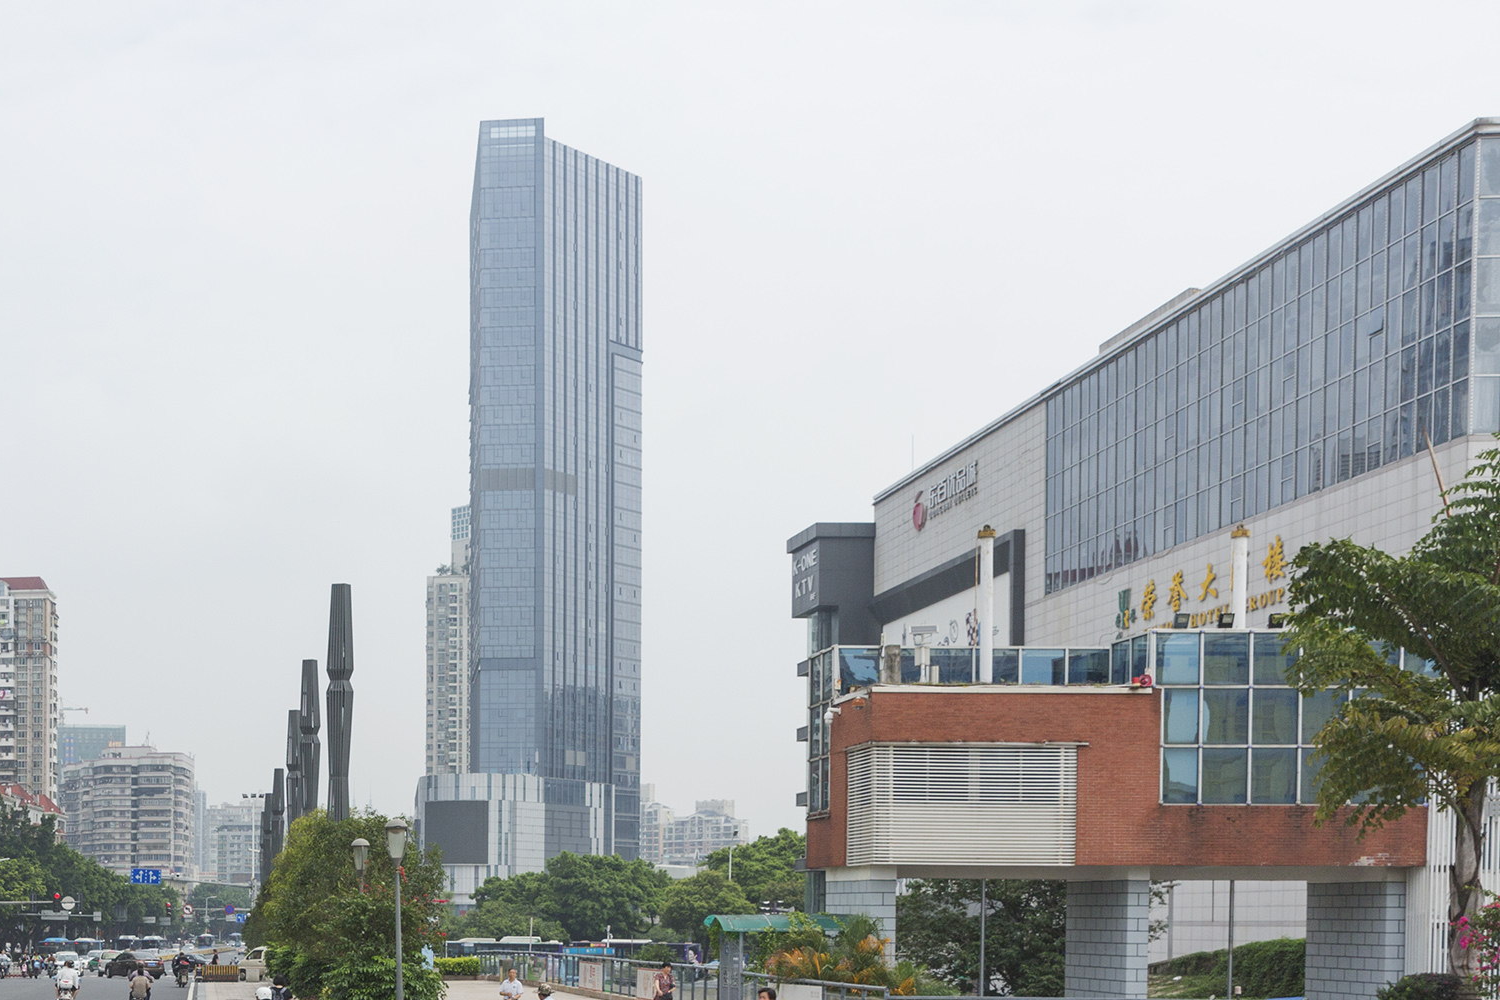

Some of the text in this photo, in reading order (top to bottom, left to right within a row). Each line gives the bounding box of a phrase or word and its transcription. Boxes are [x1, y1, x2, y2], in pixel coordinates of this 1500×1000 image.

[793, 549, 817, 577] K-ONE
[795, 575, 815, 599] KTV
[1140, 534, 1288, 621] 荣誉大楼
[1246, 588, 1285, 614] ROUP
